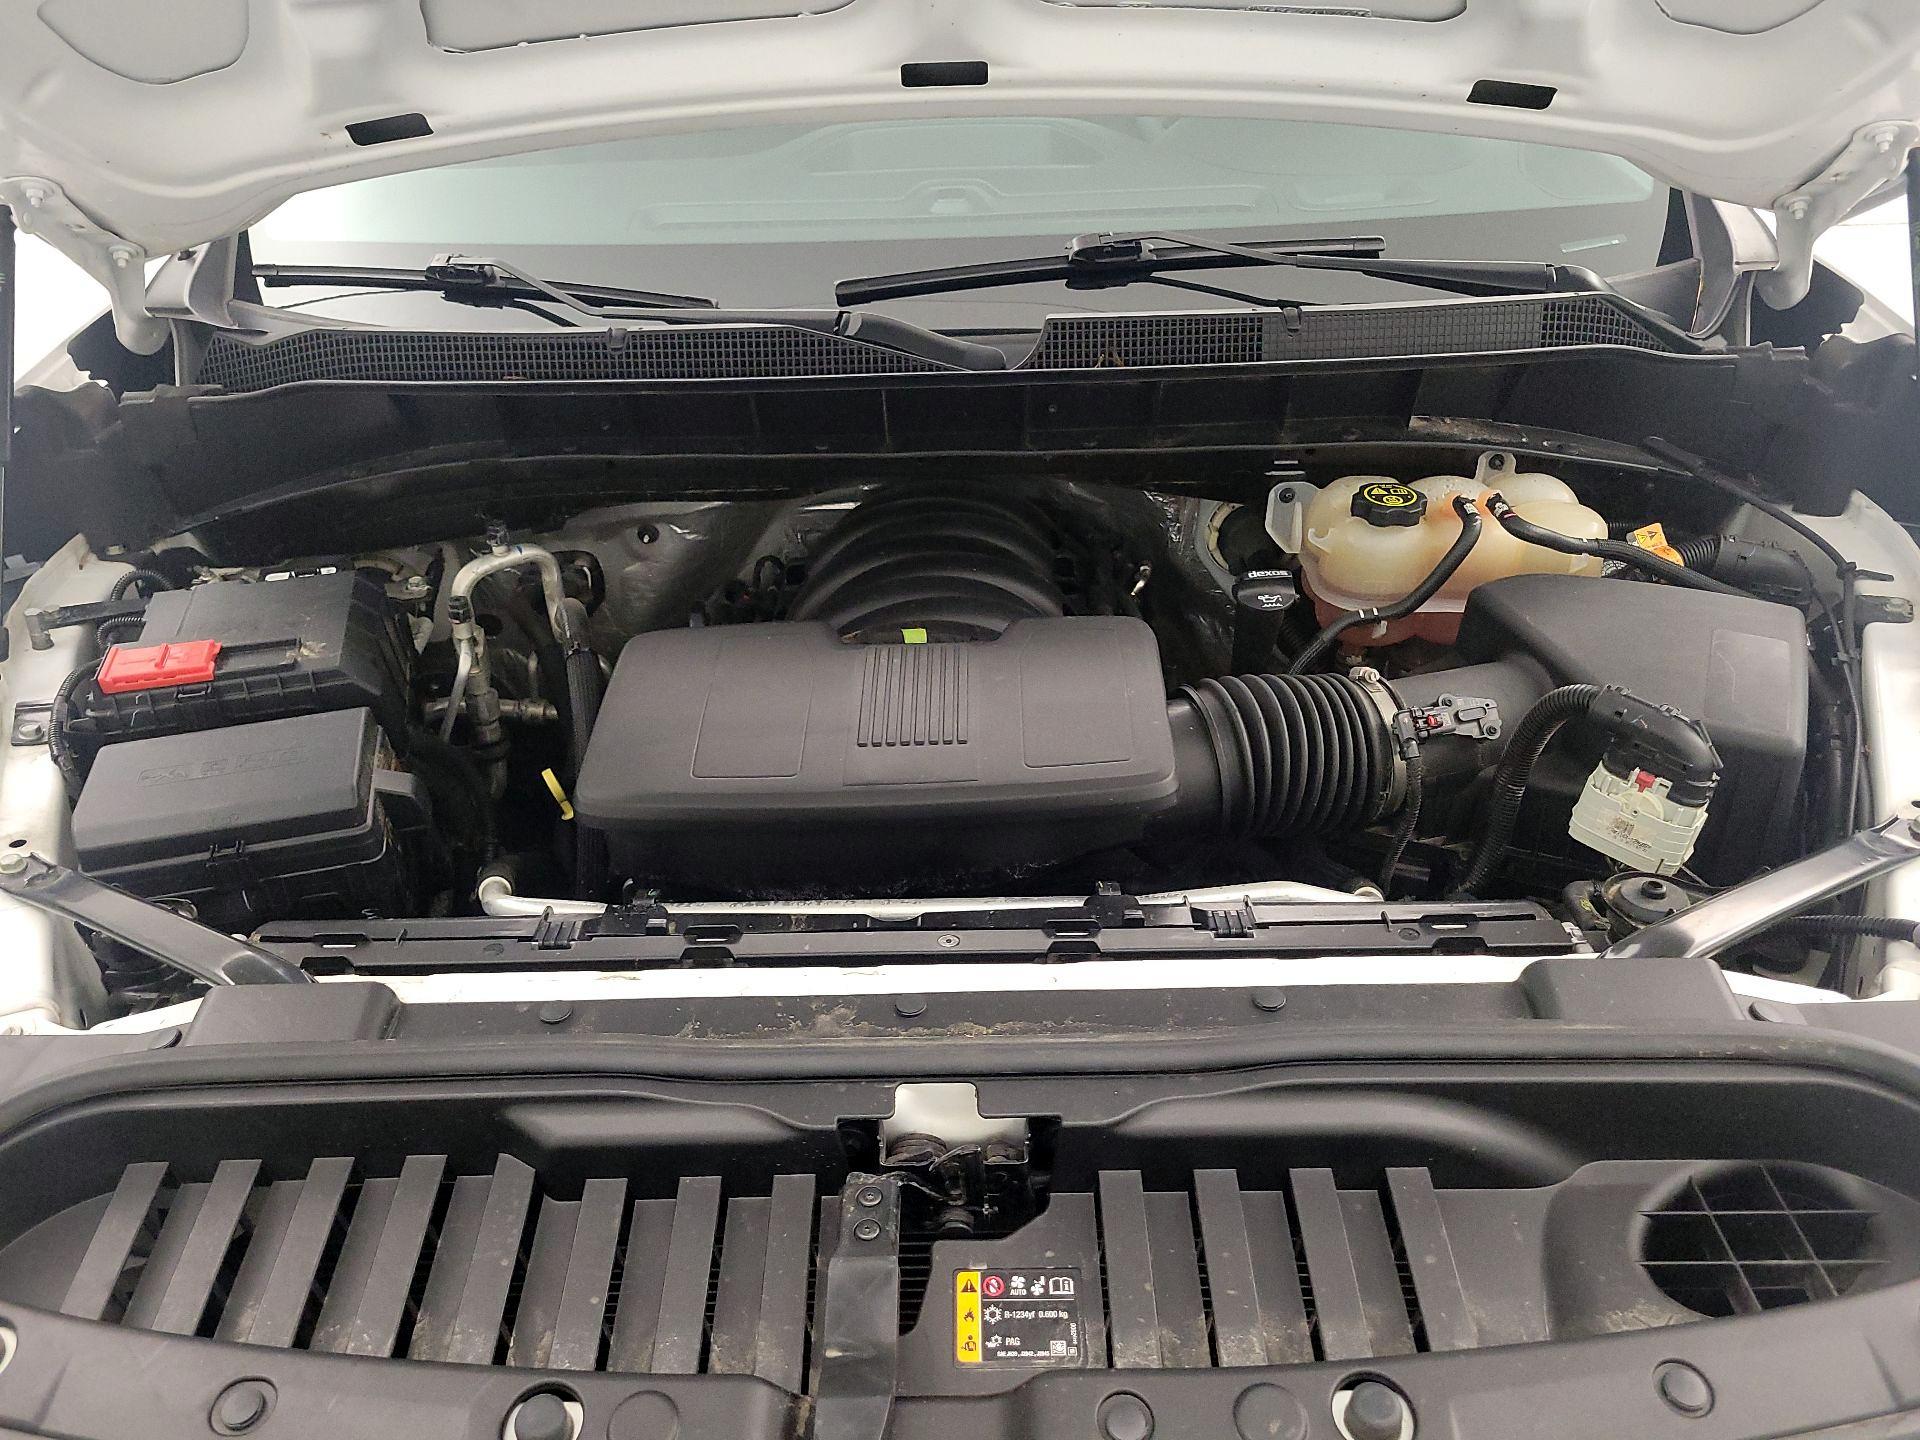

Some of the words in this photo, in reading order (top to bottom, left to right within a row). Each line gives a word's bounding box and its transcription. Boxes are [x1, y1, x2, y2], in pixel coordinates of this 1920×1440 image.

[1248, 570, 1288, 578] dexos
[1010, 1288, 1027, 1296] AUTO
[1004, 1310, 1035, 1319] R-1234yf
[1059, 1310, 1068, 1319] kg
[1005, 1337, 1021, 1346] PAG
